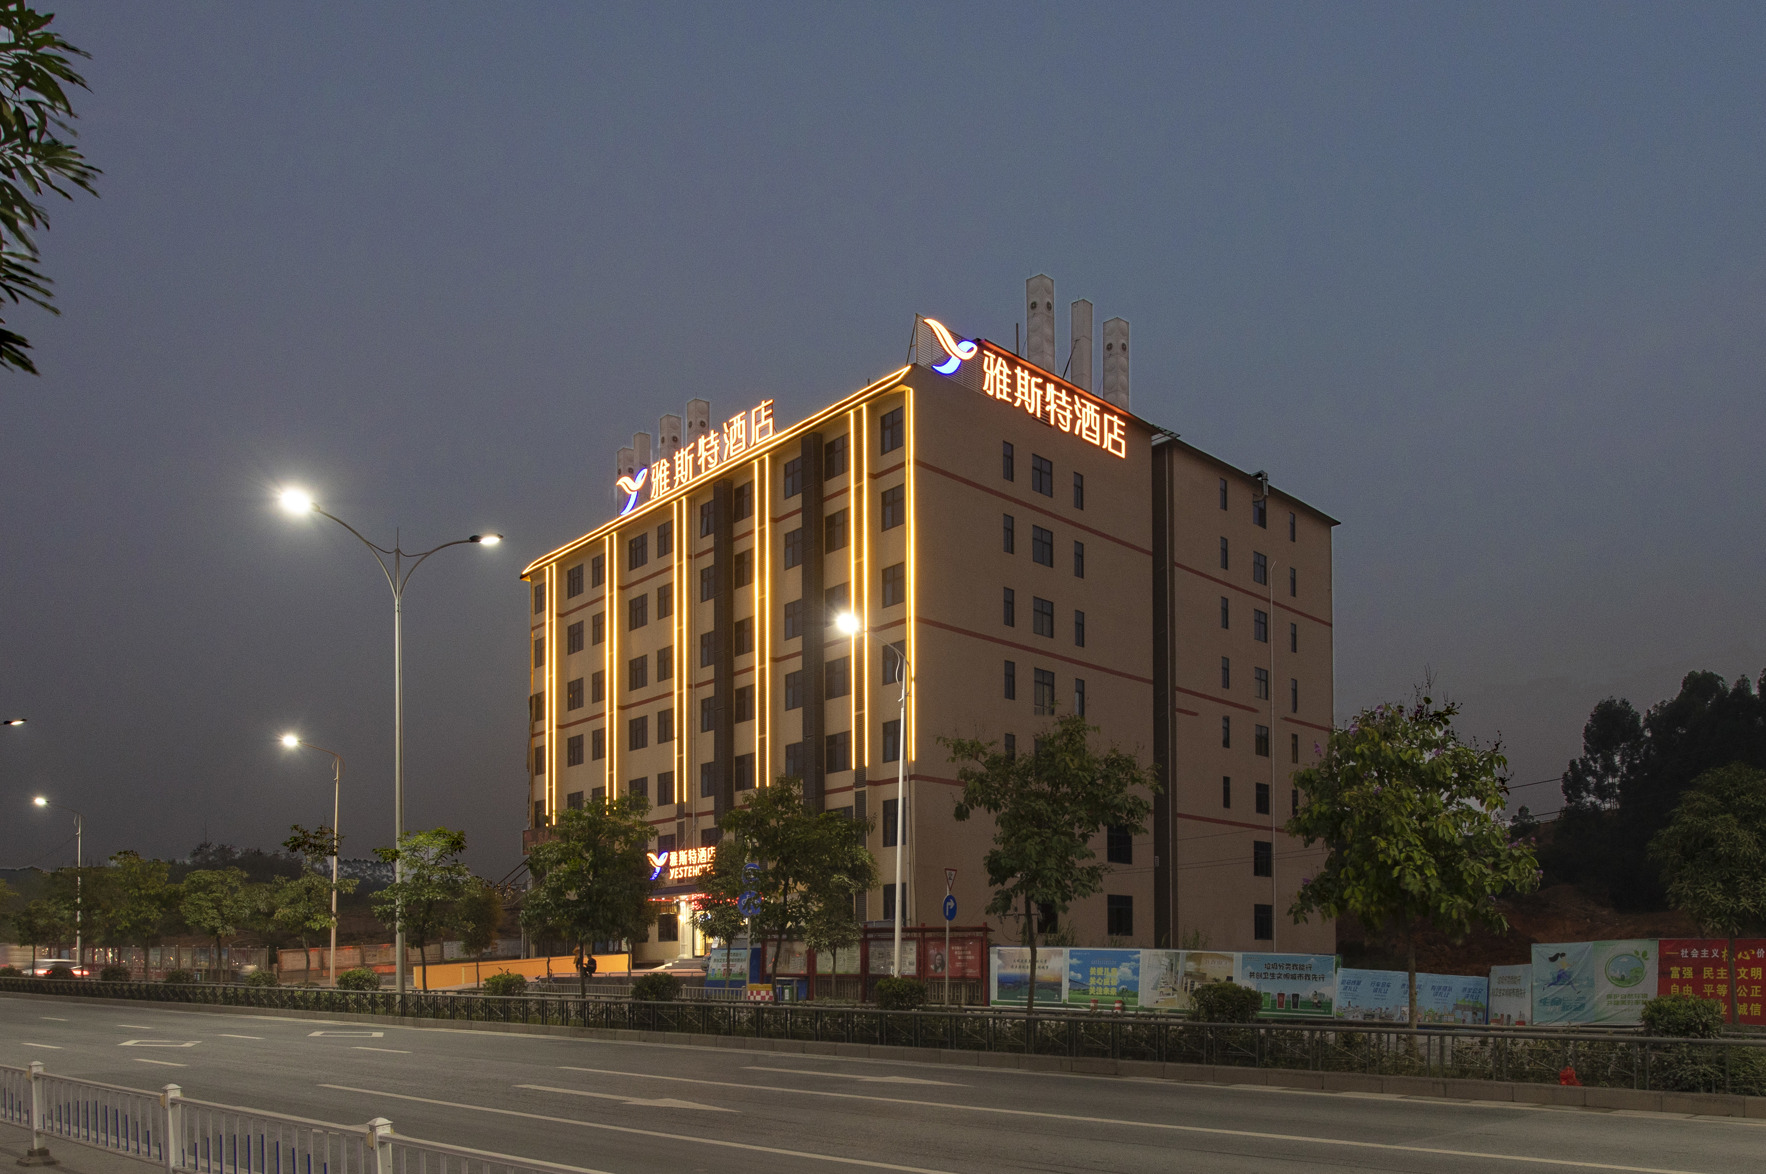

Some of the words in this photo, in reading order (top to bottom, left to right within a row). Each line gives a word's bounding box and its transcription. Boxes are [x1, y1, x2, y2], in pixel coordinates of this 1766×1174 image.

[982, 349, 1127, 460] 雅斯特酒店
[649, 398, 775, 499] 雅斯特酒店
[669, 846, 716, 867] 雅斯特酒店
[1670, 966, 1694, 979] 富强
[1702, 966, 1728, 980] 民主
[1736, 966, 1763, 980] 文明
[1670, 984, 1694, 995] 自由
[1702, 984, 1728, 997] 平等
[1736, 984, 1763, 998] 公正
